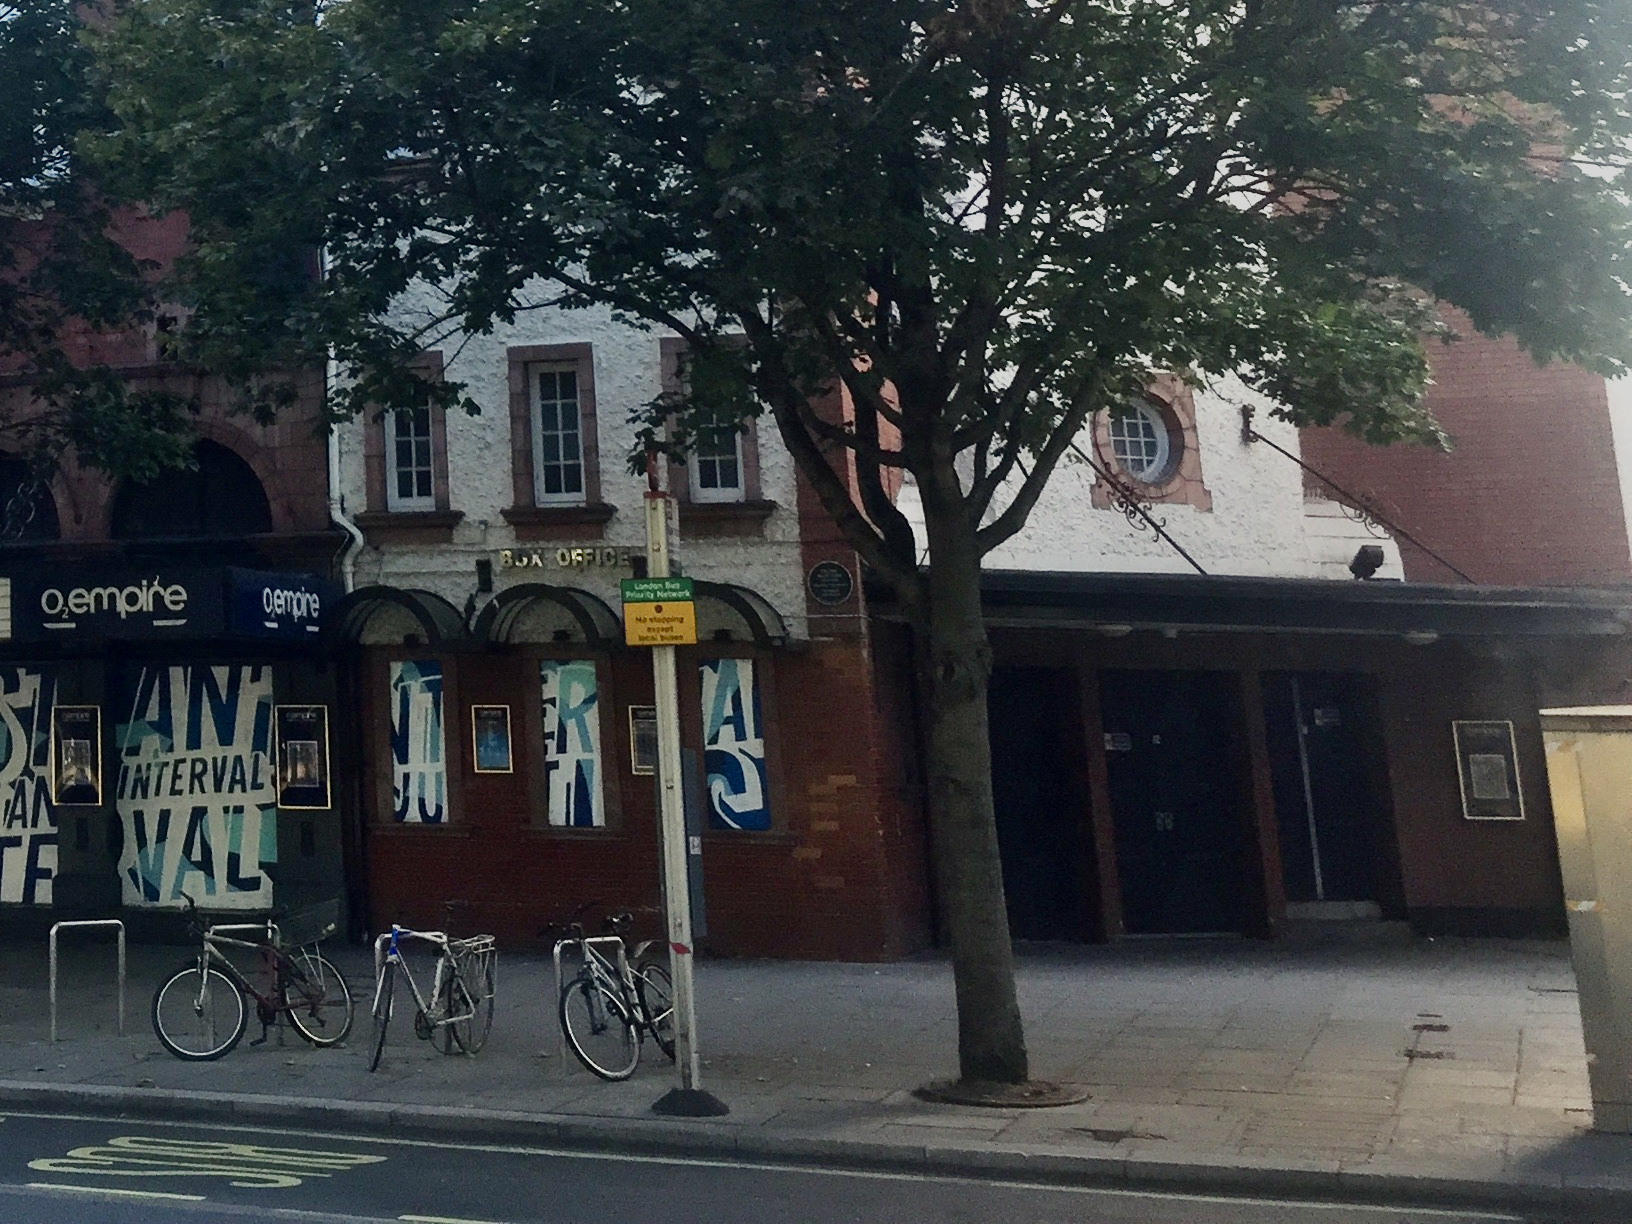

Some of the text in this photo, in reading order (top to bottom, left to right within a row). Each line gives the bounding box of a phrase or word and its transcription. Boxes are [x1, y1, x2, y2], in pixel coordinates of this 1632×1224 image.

[555, 547, 631, 566] OFFICE
[634, 580, 680, 590] London Bus
[625, 589, 691, 599] Priority Network
[635, 615, 685, 624] No stopping
[646, 625, 674, 634] except
[118, 753, 265, 800] INTERVAL
